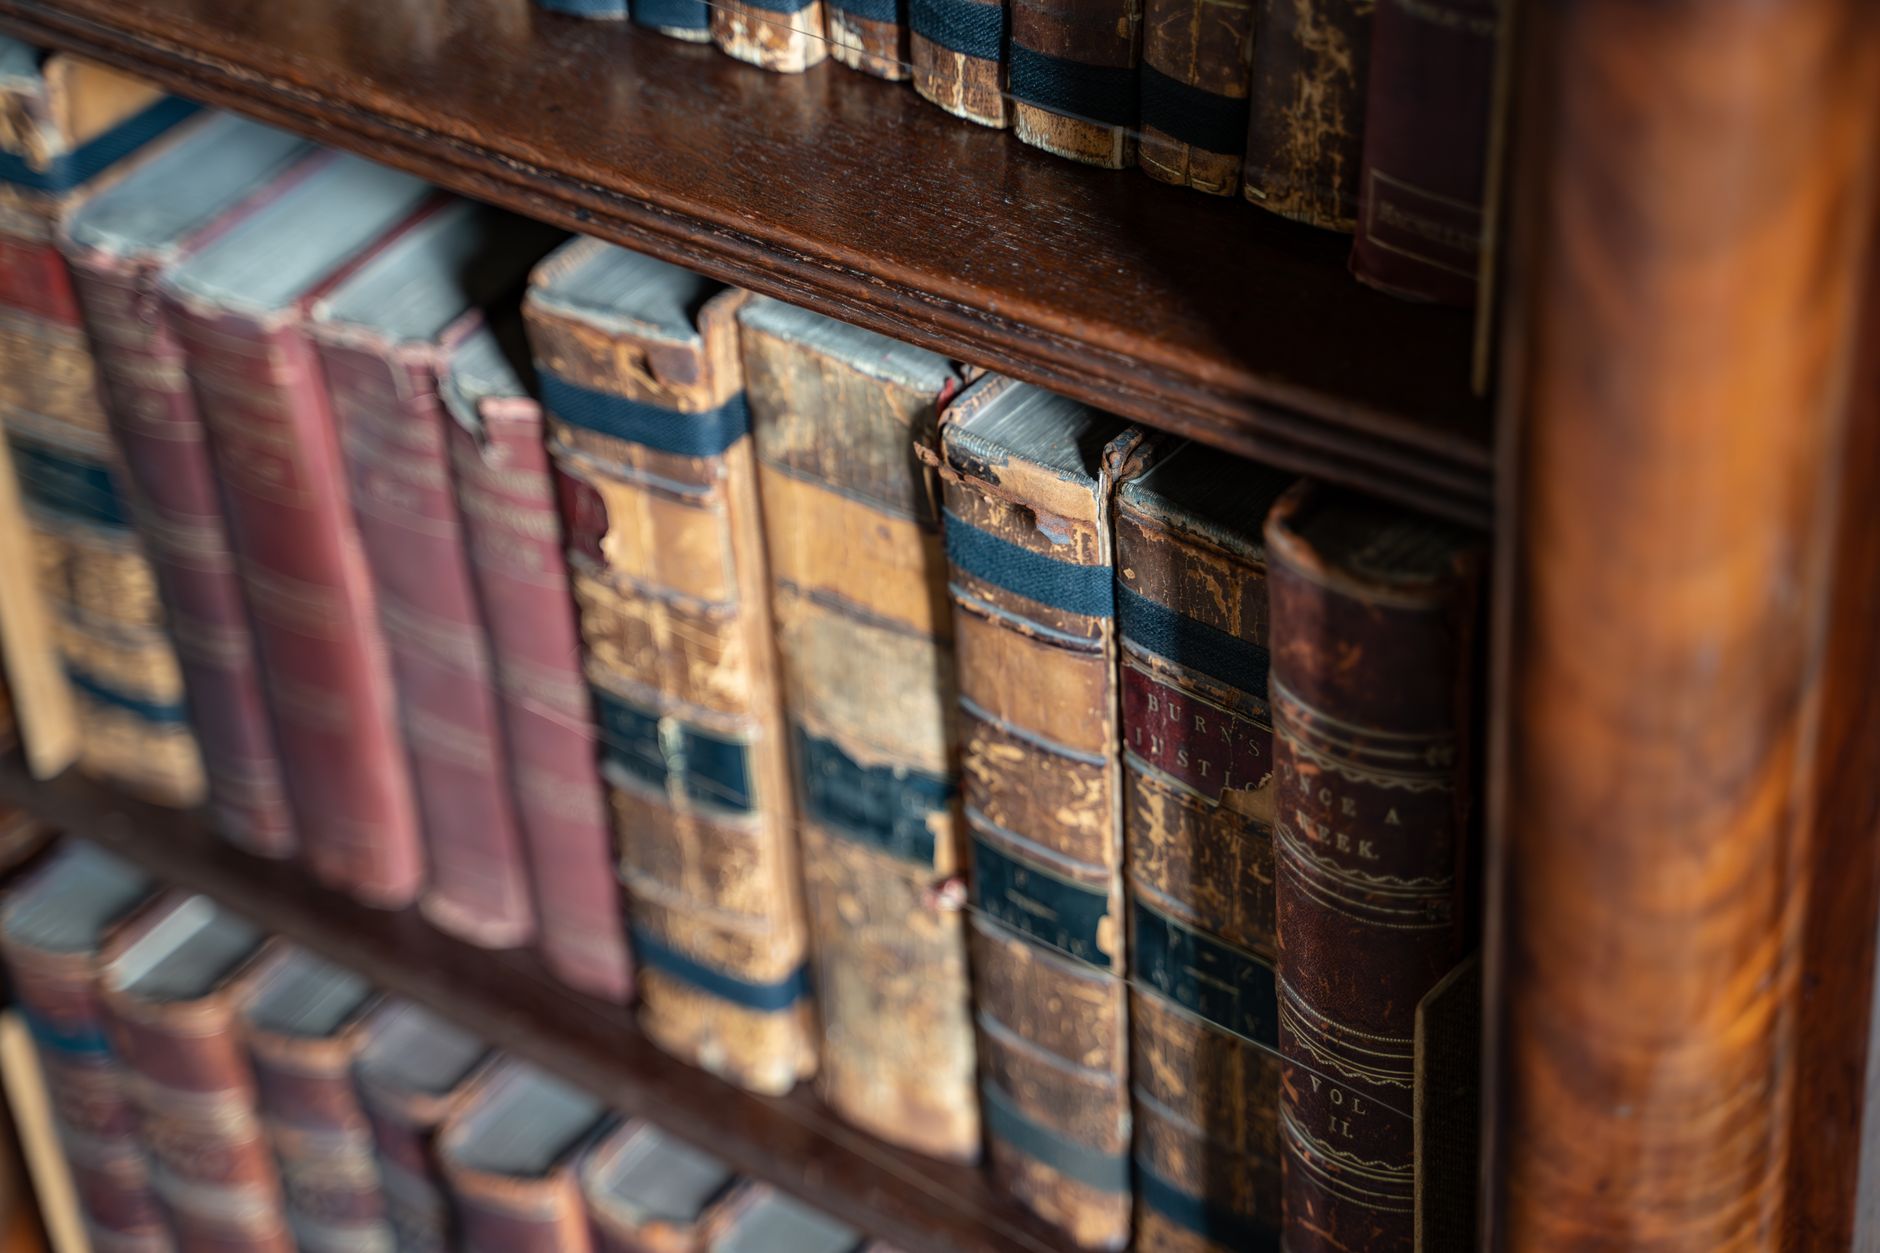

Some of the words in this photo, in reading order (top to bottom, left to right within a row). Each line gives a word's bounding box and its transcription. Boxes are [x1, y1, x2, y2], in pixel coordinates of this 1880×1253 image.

[1147, 693, 1260, 757] BURN'S
[1383, 807, 1401, 826] A
[1310, 1074, 1366, 1116] VOL
